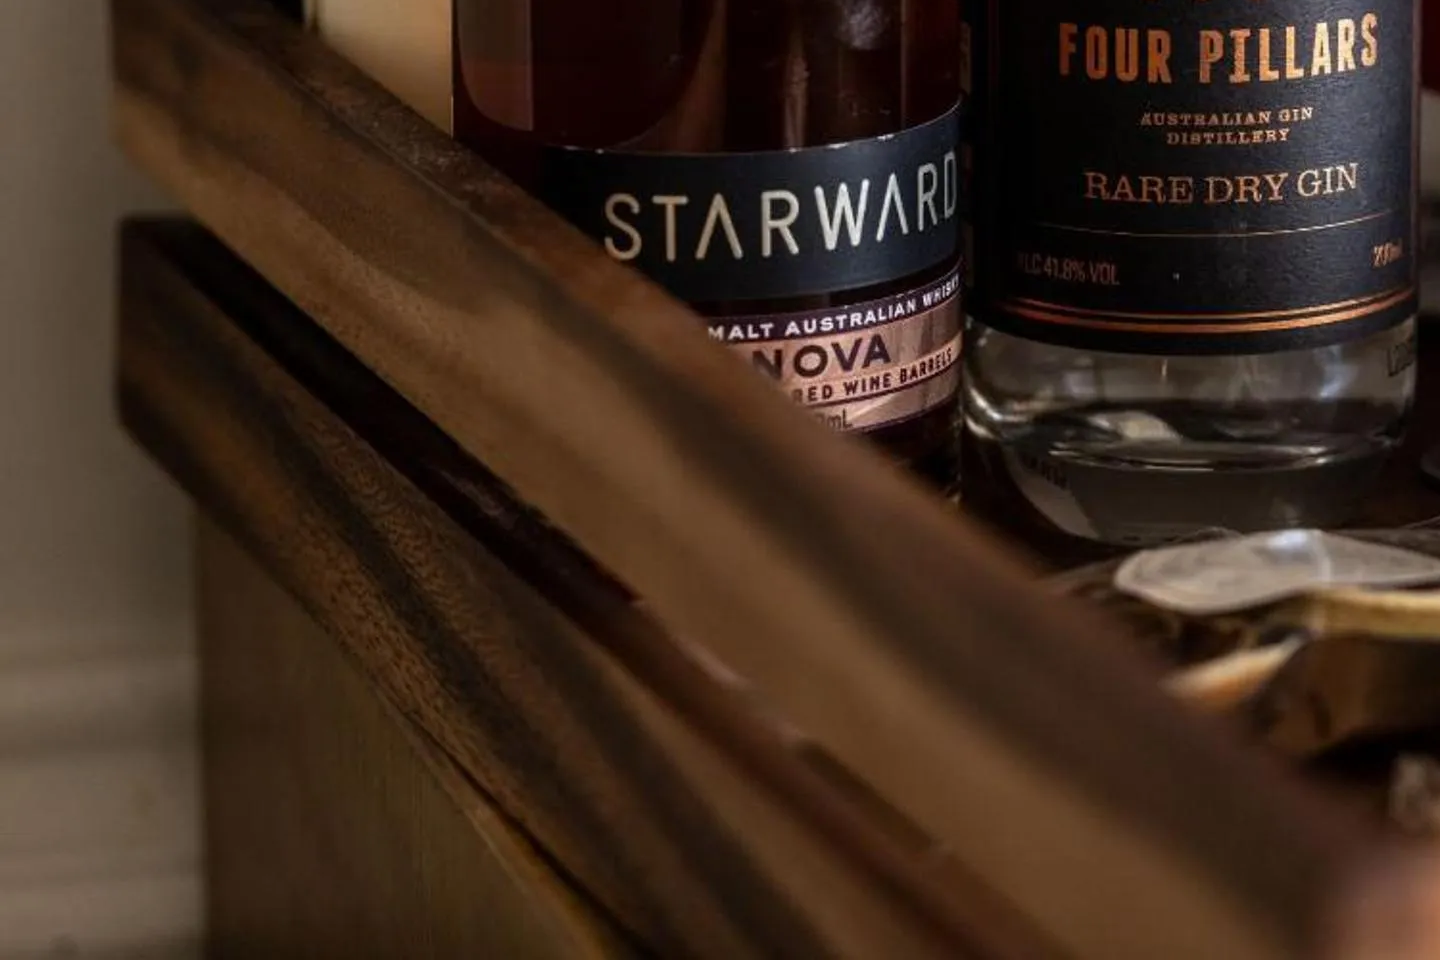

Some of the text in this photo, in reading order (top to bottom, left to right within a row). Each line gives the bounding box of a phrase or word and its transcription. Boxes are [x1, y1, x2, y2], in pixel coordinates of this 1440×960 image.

[1058, 12, 1379, 85] FOUR PILLARS
[1140, 106, 1314, 126] AUSTRALIAN GIN
[1166, 128, 1290, 146] DISTILLERY
[1083, 162, 1358, 204] RARE DRY GIN
[604, 151, 957, 263] STARWARD
[1017, 252, 1041, 275] LC
[707, 322, 774, 340] MALT
[784, 297, 917, 337] AUSTRALIAN
[751, 334, 892, 380] NOVA
[843, 373, 892, 397] WINE
[899, 347, 953, 383] BARRELS
